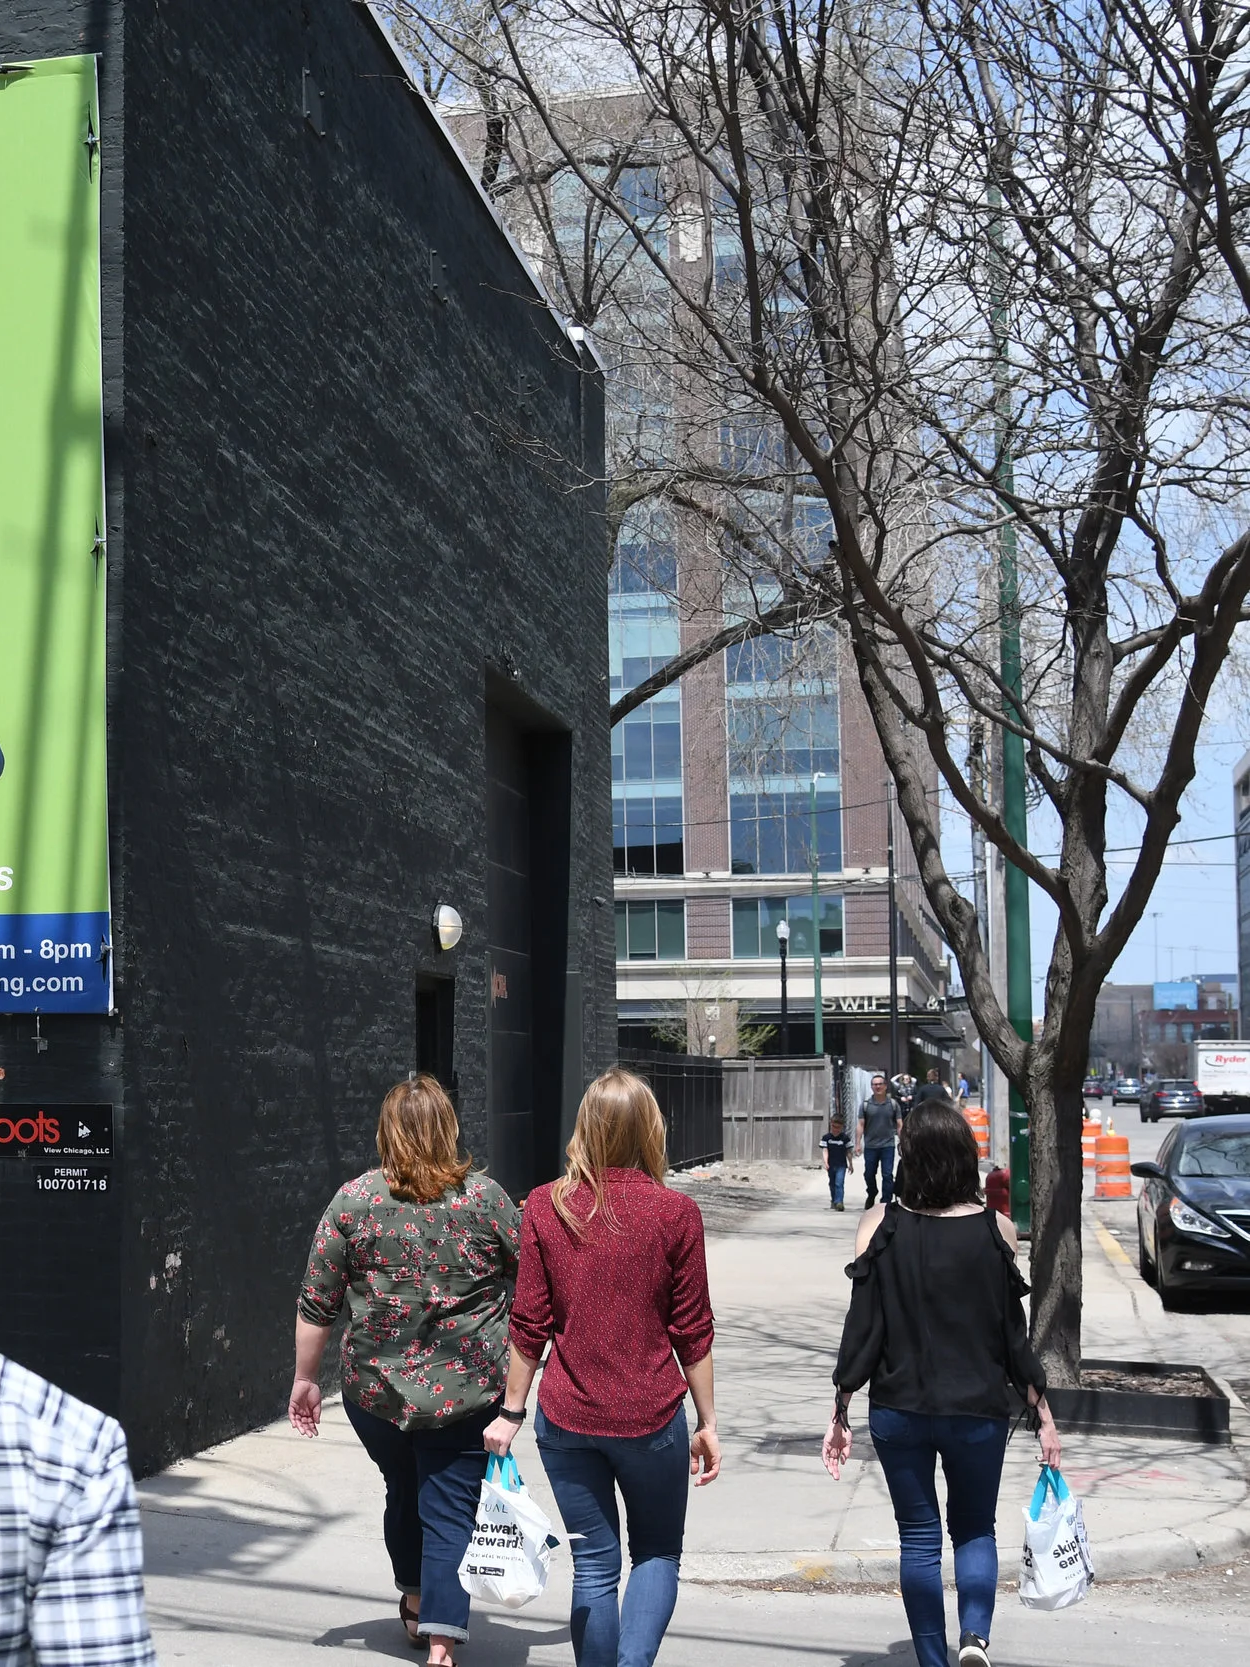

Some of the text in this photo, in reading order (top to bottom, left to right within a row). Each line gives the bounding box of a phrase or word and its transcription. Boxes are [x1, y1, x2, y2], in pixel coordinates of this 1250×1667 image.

[39, 939, 92, 964] 8pm
[821, 996, 883, 1012] SWIF
[1215, 1055, 1246, 1064] Ryder
[63, 1147, 95, 1155] Chicago,
[54, 1168, 88, 1177] PERMIT
[36, 1178, 107, 1191] 100701718
[478, 1502, 509, 1514] TUAL
[1053, 1540, 1076, 1558] skip
